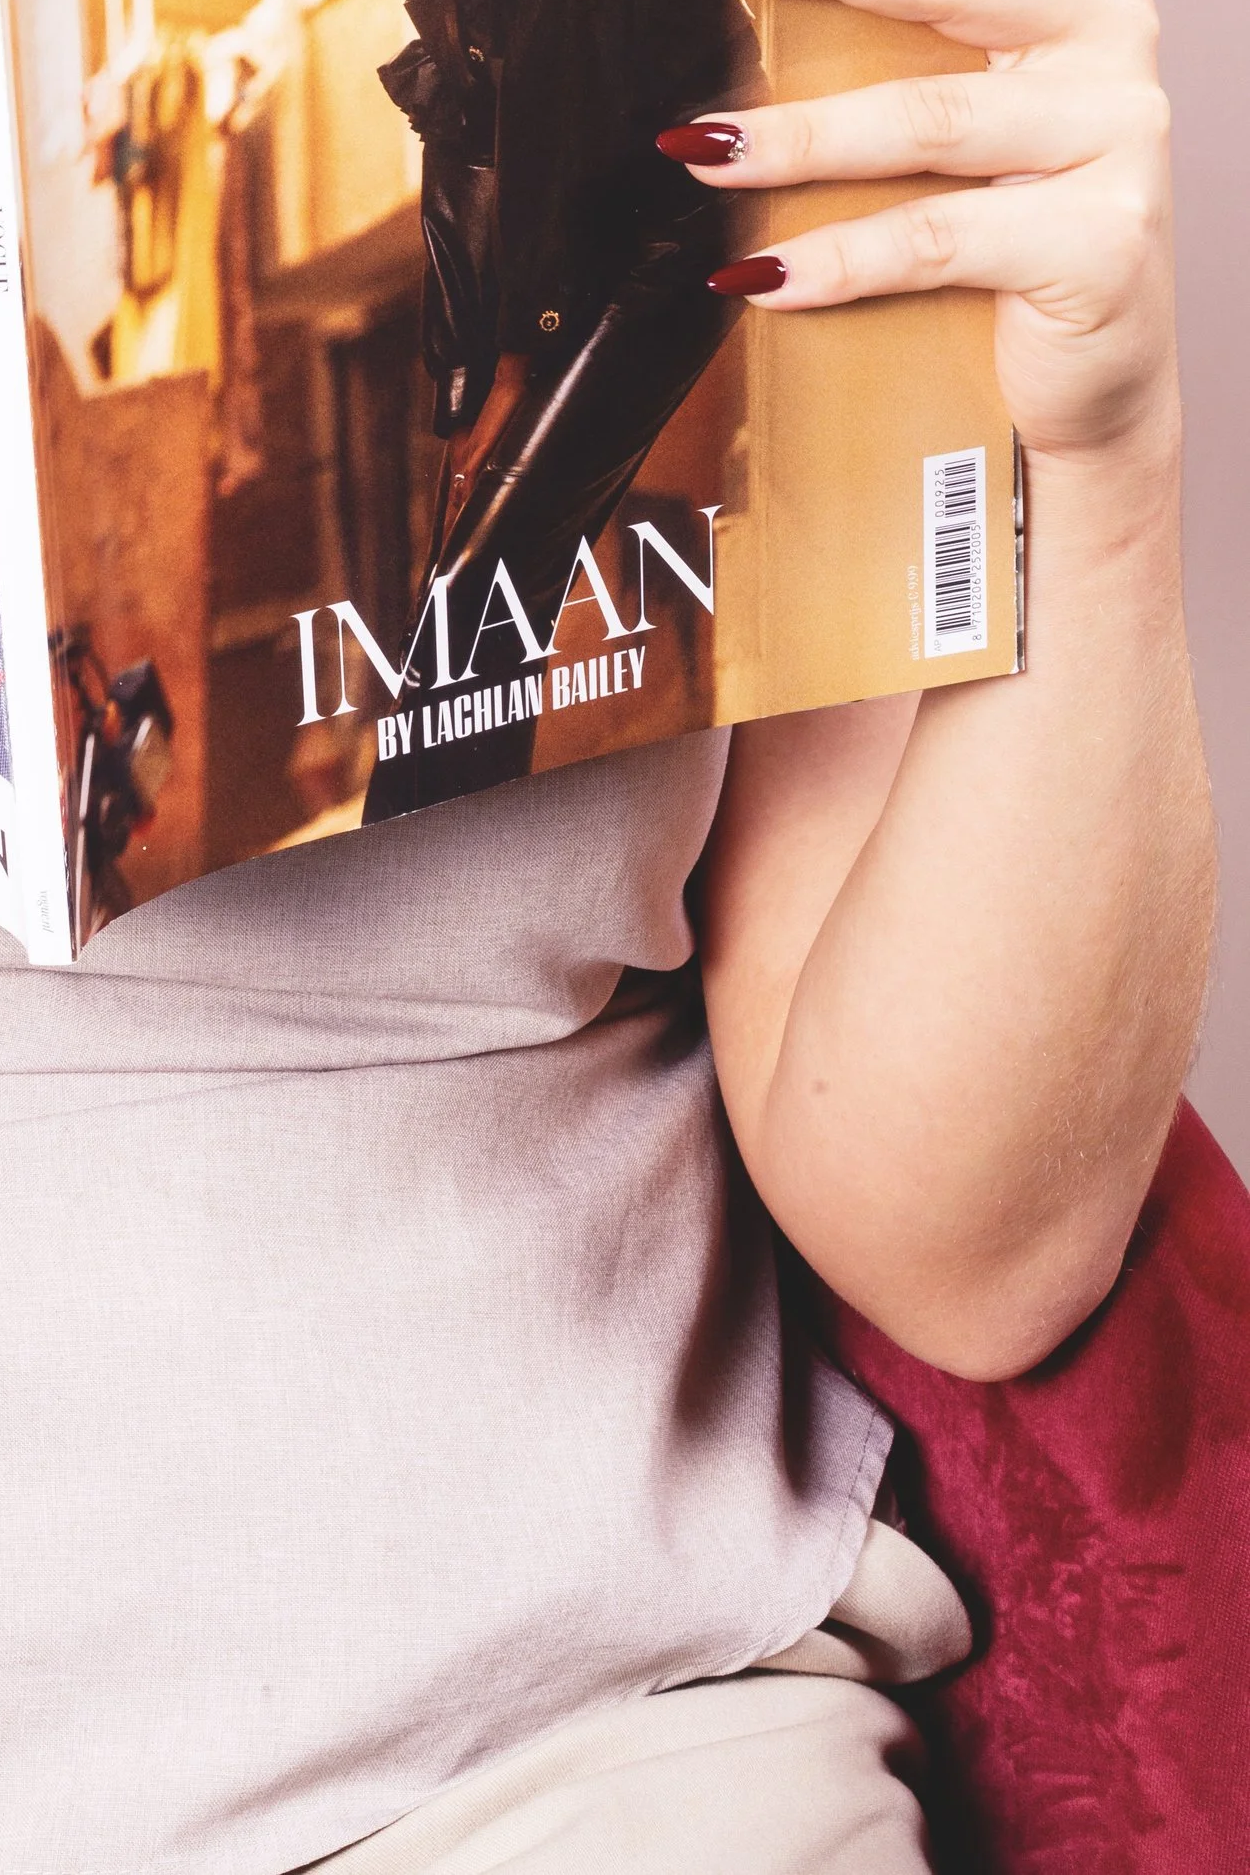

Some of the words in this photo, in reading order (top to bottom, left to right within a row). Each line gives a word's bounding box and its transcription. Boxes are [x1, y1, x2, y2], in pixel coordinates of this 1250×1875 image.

[934, 468, 945, 518] 00925
[291, 504, 725, 727] IMAAN
[377, 710, 415, 762] BY
[422, 672, 544, 749] LACHLAN
[552, 645, 647, 711] BAILEY
